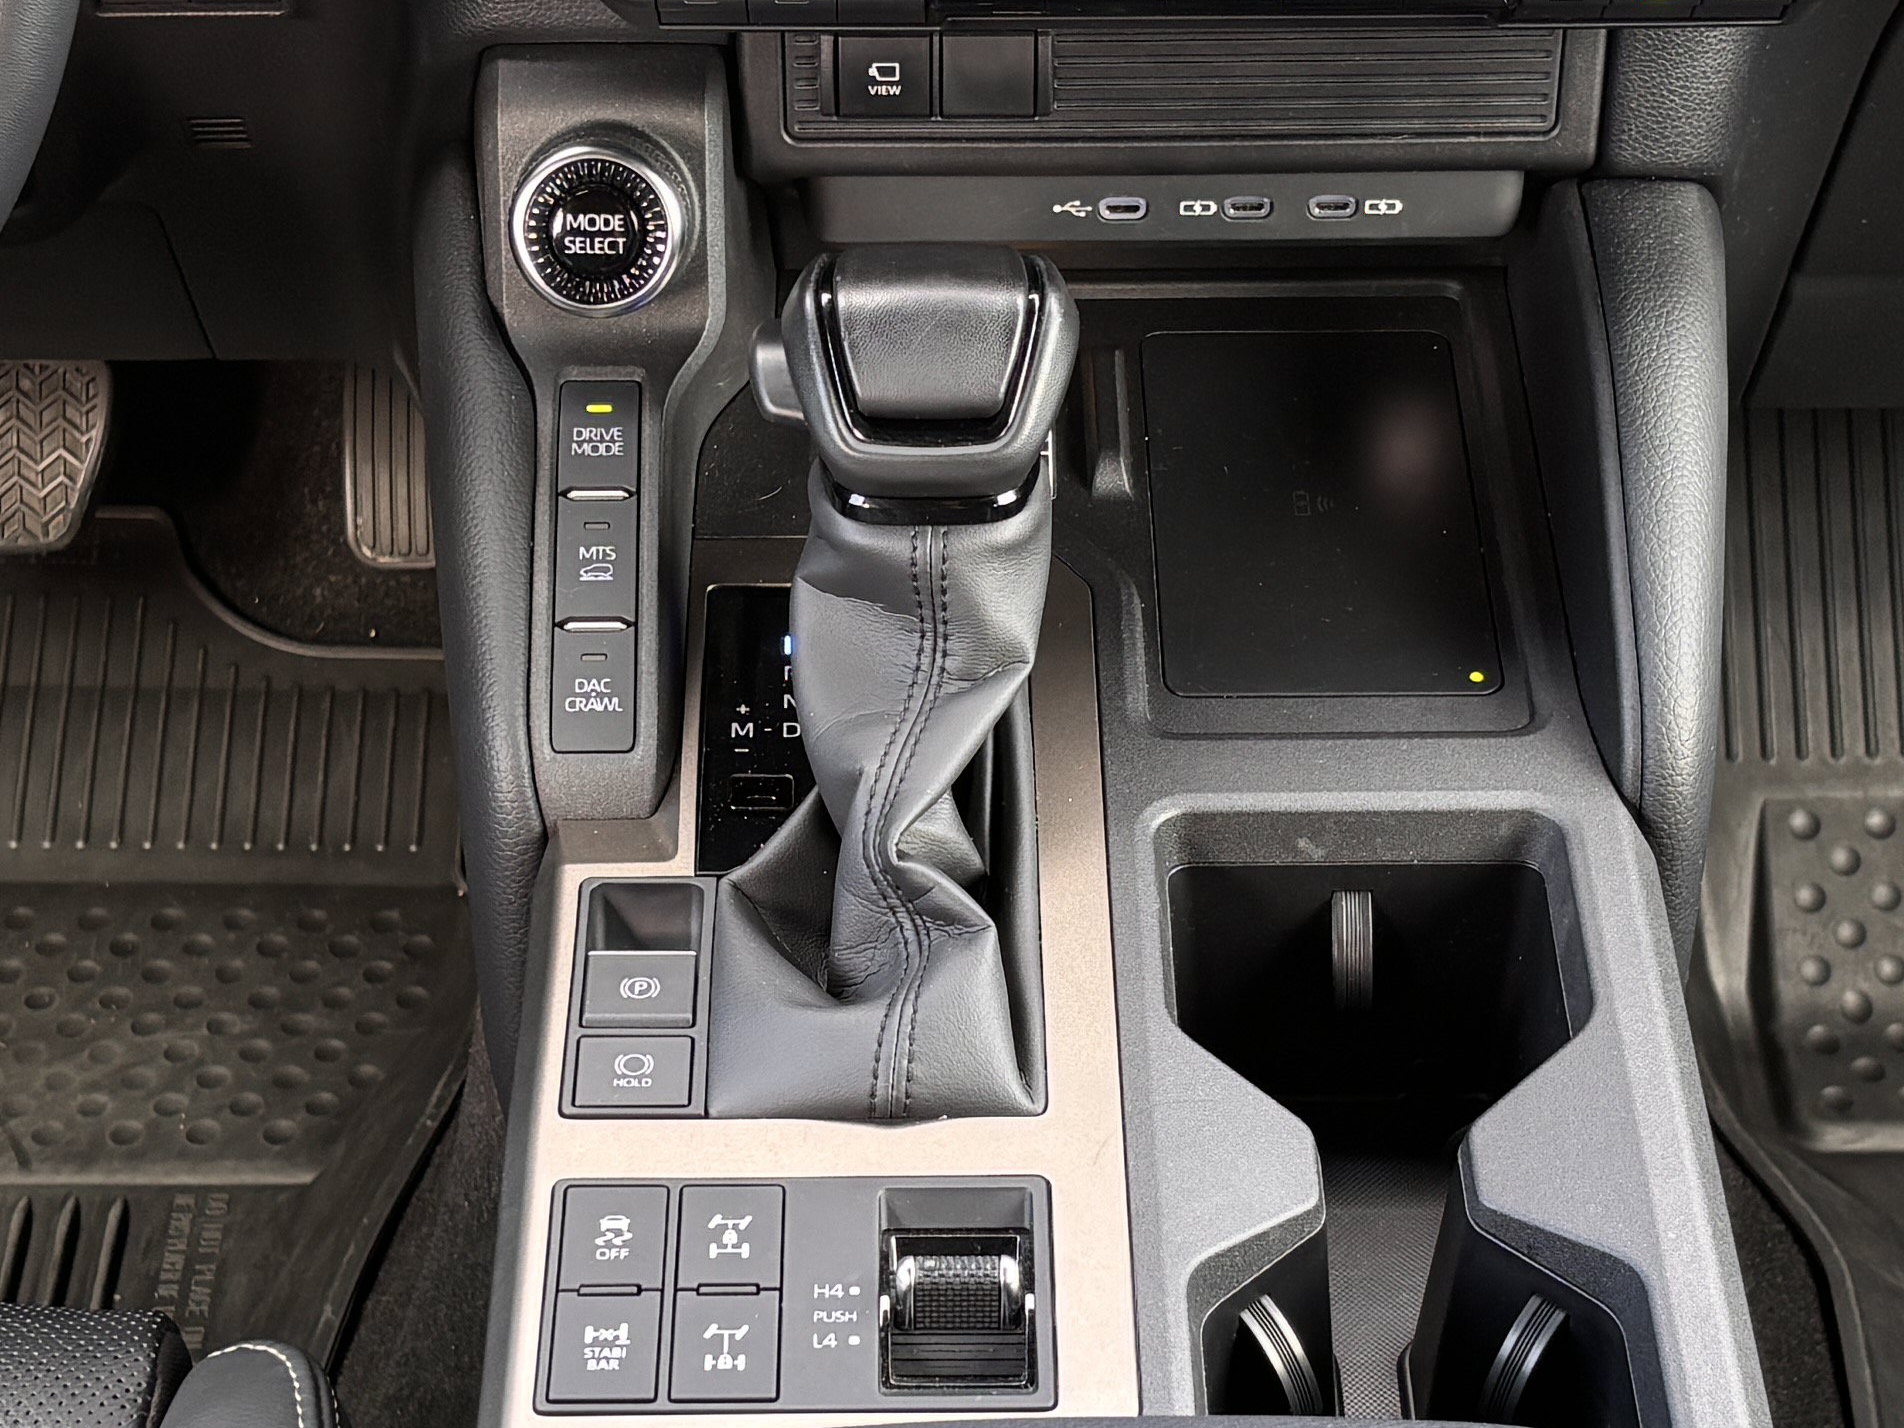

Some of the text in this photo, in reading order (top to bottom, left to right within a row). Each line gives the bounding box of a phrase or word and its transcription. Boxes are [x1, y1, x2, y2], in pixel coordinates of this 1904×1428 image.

[867, 85, 901, 97] VIEW
[566, 213, 625, 231] MODE
[564, 237, 626, 254] SELECT
[573, 426, 623, 442] DRIVE
[571, 442, 624, 457] MODE
[579, 546, 616, 561] MTS
[574, 678, 611, 694] DAC
[565, 696, 623, 712] CRAWL
[731, 722, 754, 738] M
[782, 722, 801, 738] D
[613, 1078, 652, 1087] HOLD
[596, 1248, 630, 1260] OFF
[813, 1284, 844, 1298] H4
[812, 1310, 857, 1323] PUSH
[812, 1334, 839, 1348] L4
[584, 1347, 627, 1359] STABI
[586, 1359, 620, 1371] BAR
